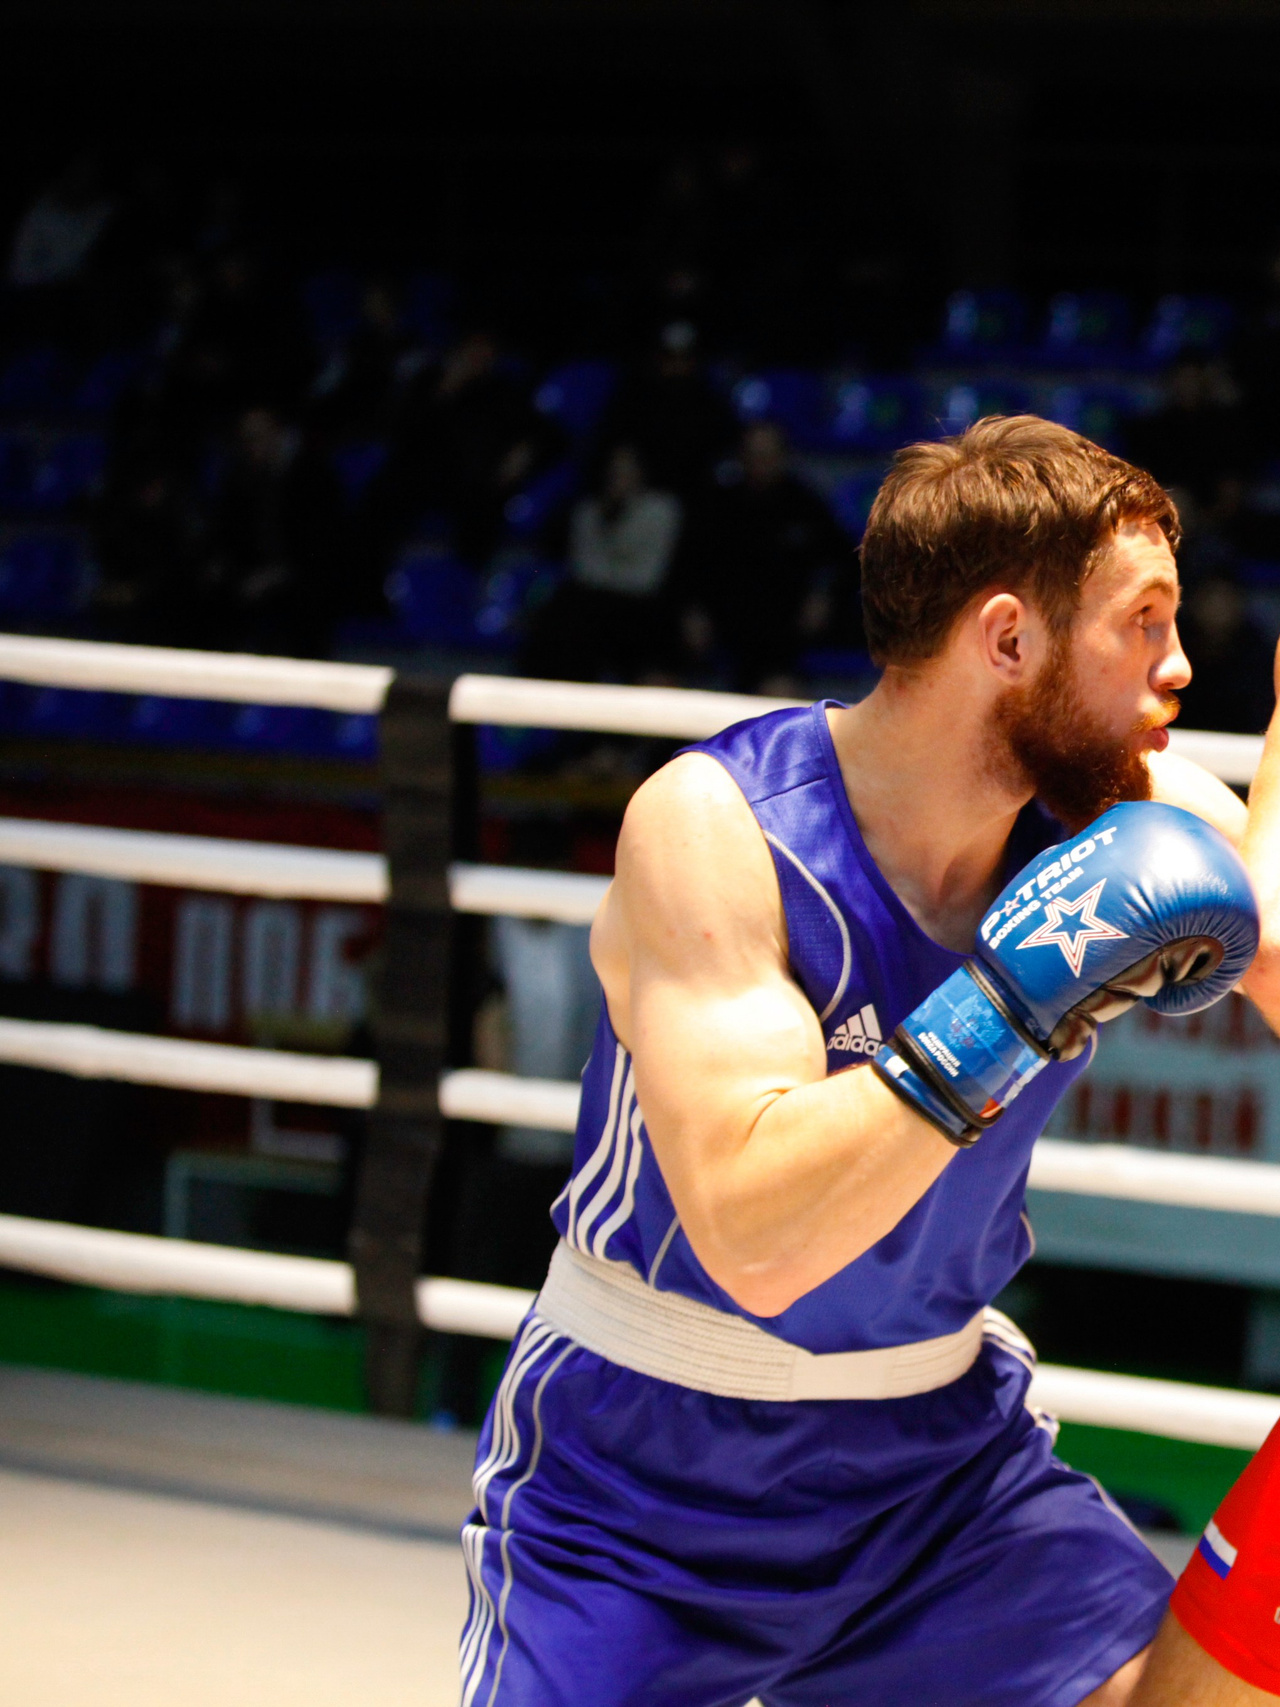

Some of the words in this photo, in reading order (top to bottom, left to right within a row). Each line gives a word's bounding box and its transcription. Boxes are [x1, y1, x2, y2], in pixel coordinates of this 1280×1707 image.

[988, 899, 1042, 950] BOXING
[1039, 866, 1084, 900] TEAM
[826, 1033, 887, 1058] adida
